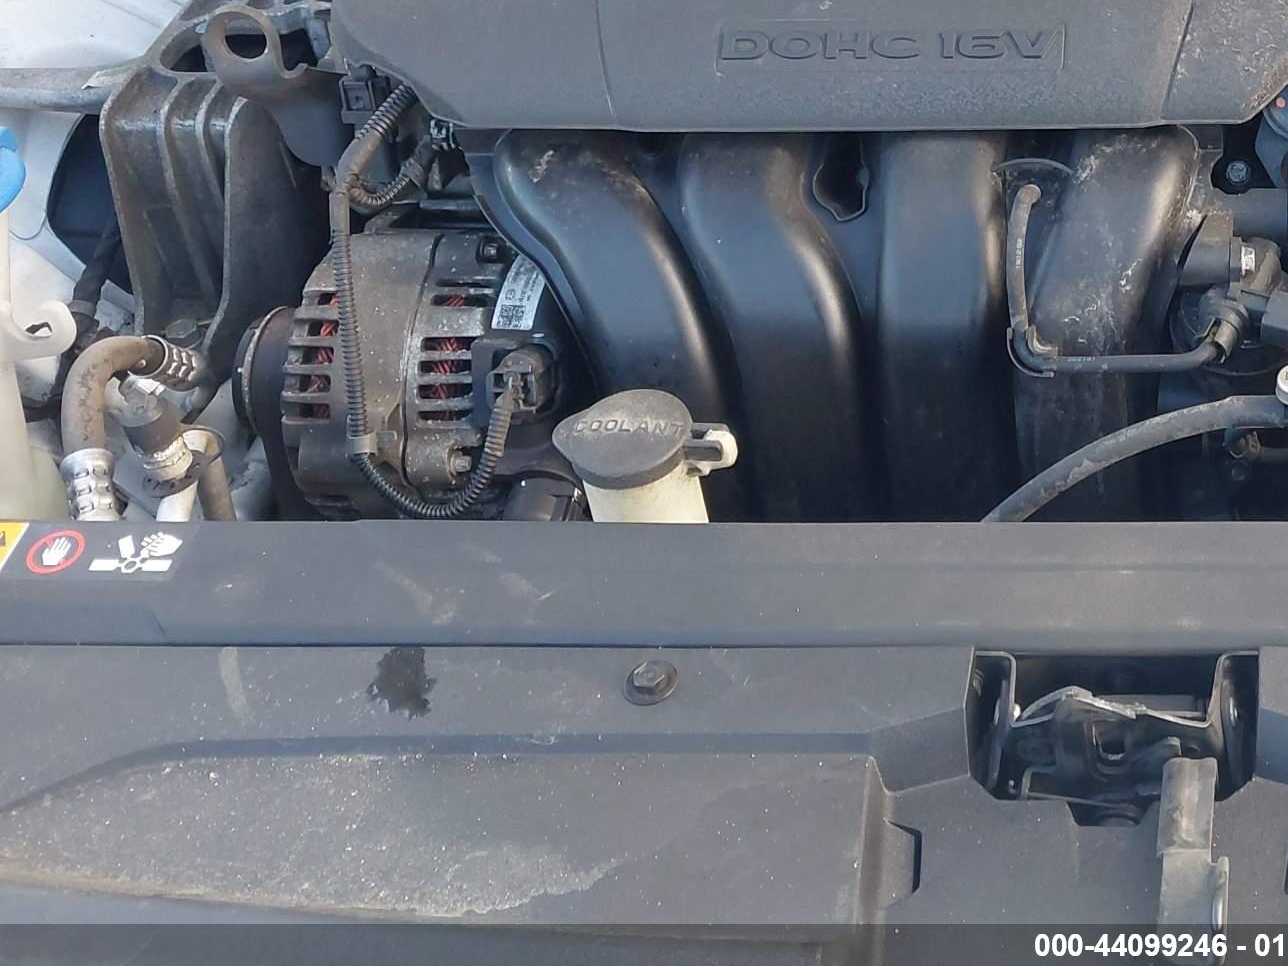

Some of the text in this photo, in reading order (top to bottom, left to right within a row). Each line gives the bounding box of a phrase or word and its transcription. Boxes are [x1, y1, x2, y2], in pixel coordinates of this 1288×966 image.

[718, 29, 1061, 61] DOHC 16V
[574, 417, 685, 437] COOLANT
